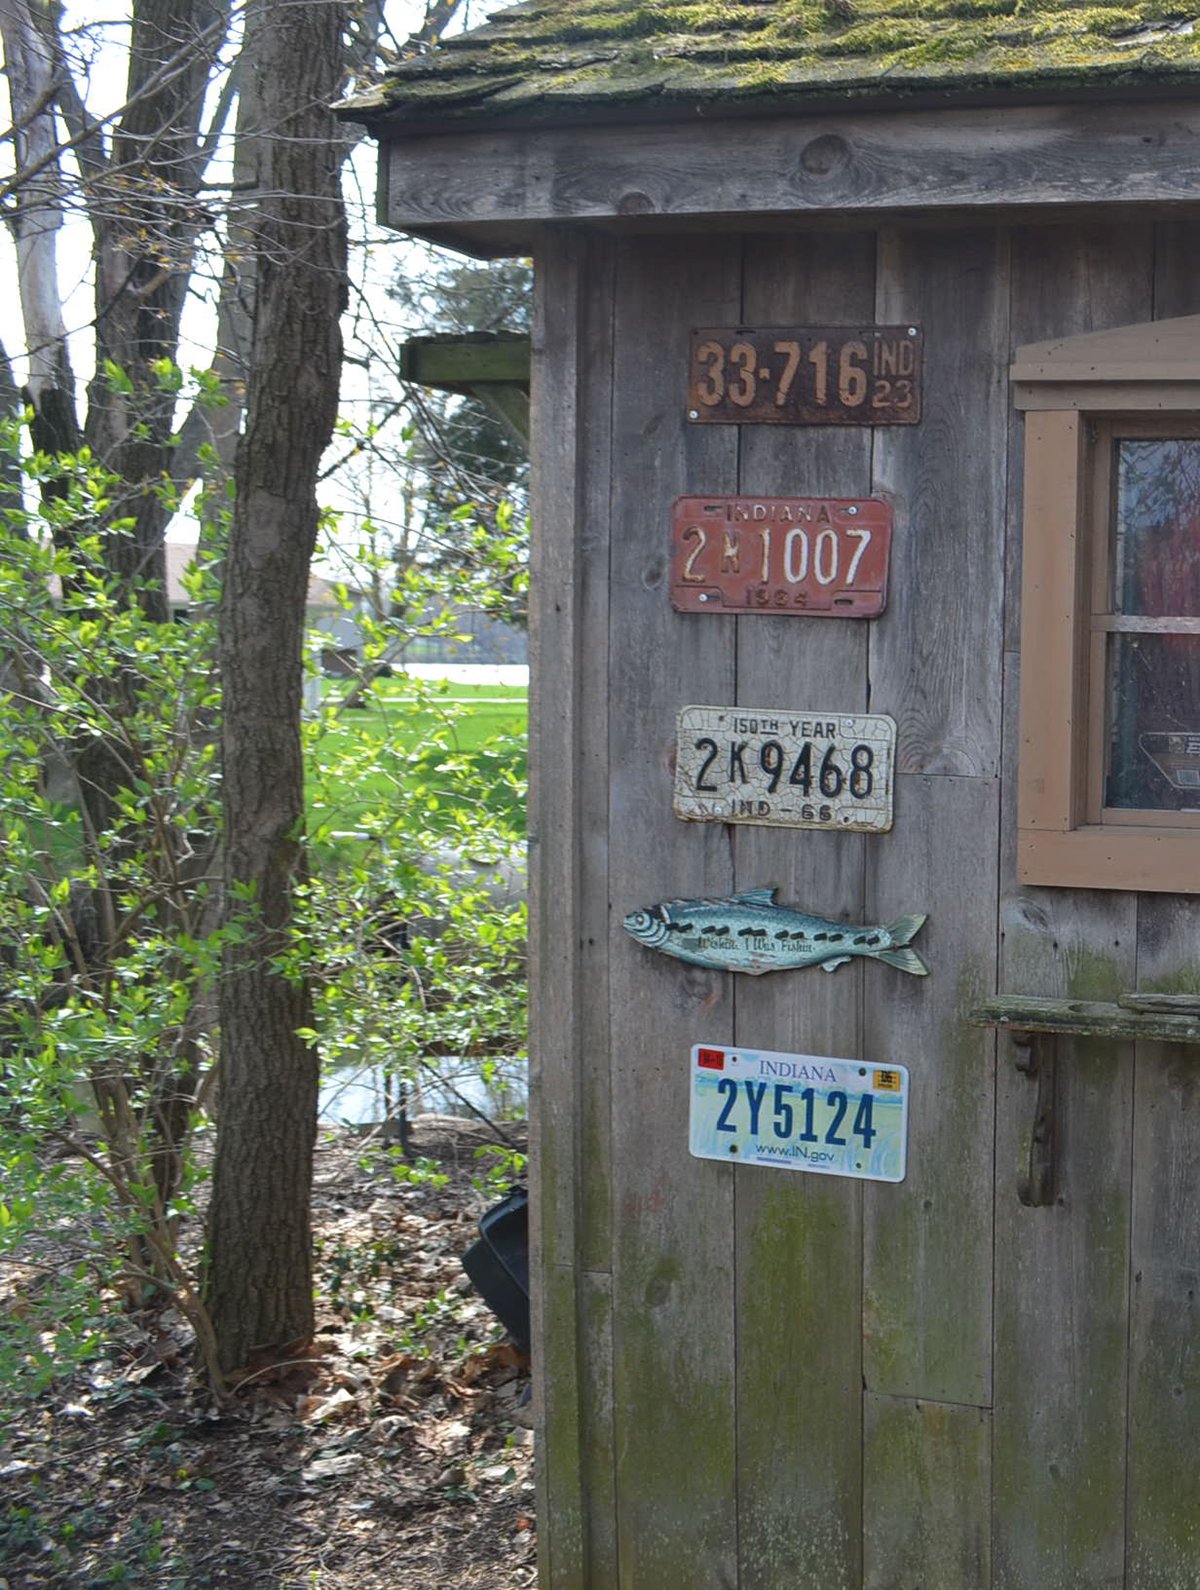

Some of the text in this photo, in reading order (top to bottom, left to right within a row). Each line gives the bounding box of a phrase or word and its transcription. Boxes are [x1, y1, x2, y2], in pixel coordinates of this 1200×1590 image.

[873, 340, 914, 376] IND
[699, 341, 867, 407] 33-716
[872, 380, 912, 408] 23
[726, 504, 832, 523] INDIANA
[790, 720, 837, 739] YEAR
[694, 738, 874, 799] 2K9468
[760, 1060, 838, 1083] INDIANA
[716, 1078, 877, 1149] 2Y5124
[756, 1144, 835, 1162] www.IN.gov
